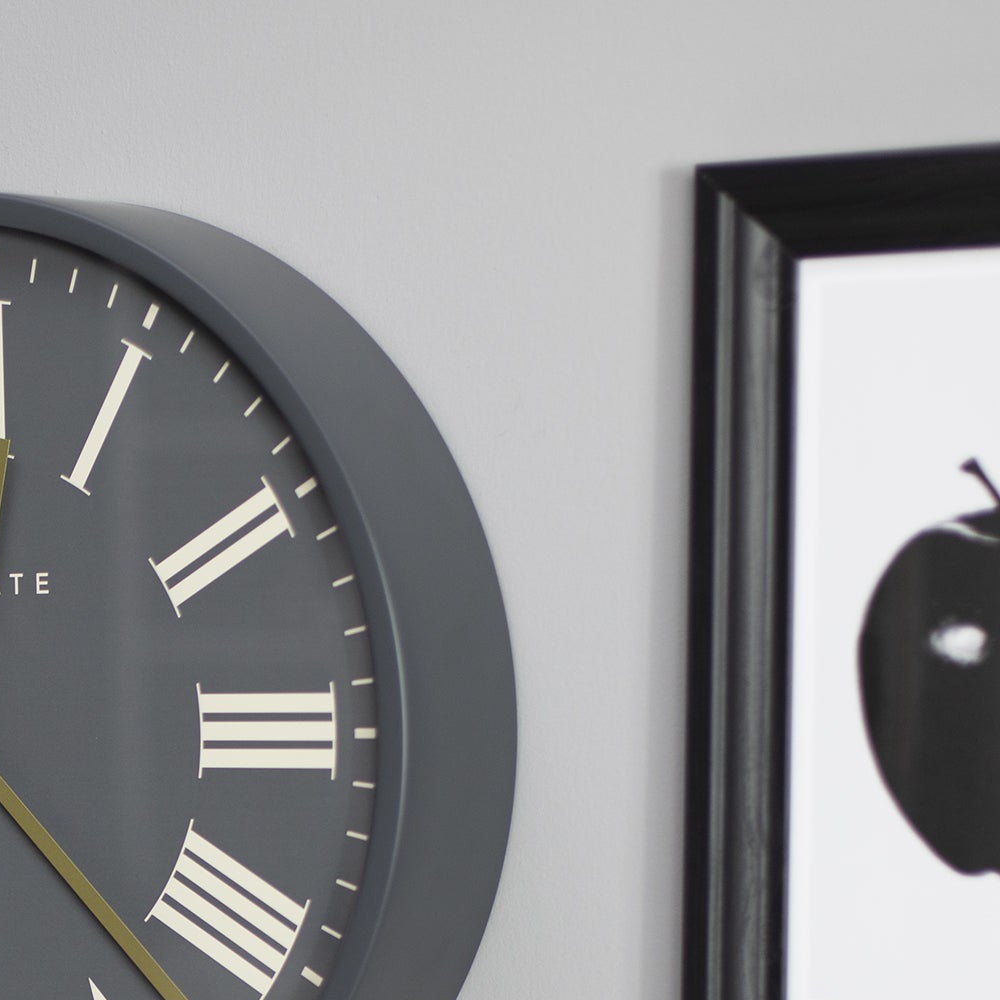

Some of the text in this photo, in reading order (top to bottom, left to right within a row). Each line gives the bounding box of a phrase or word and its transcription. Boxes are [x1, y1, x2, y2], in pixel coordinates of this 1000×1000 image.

[61, 338, 152, 495] I
[149, 476, 295, 617] II
[197, 682, 338, 779] III
